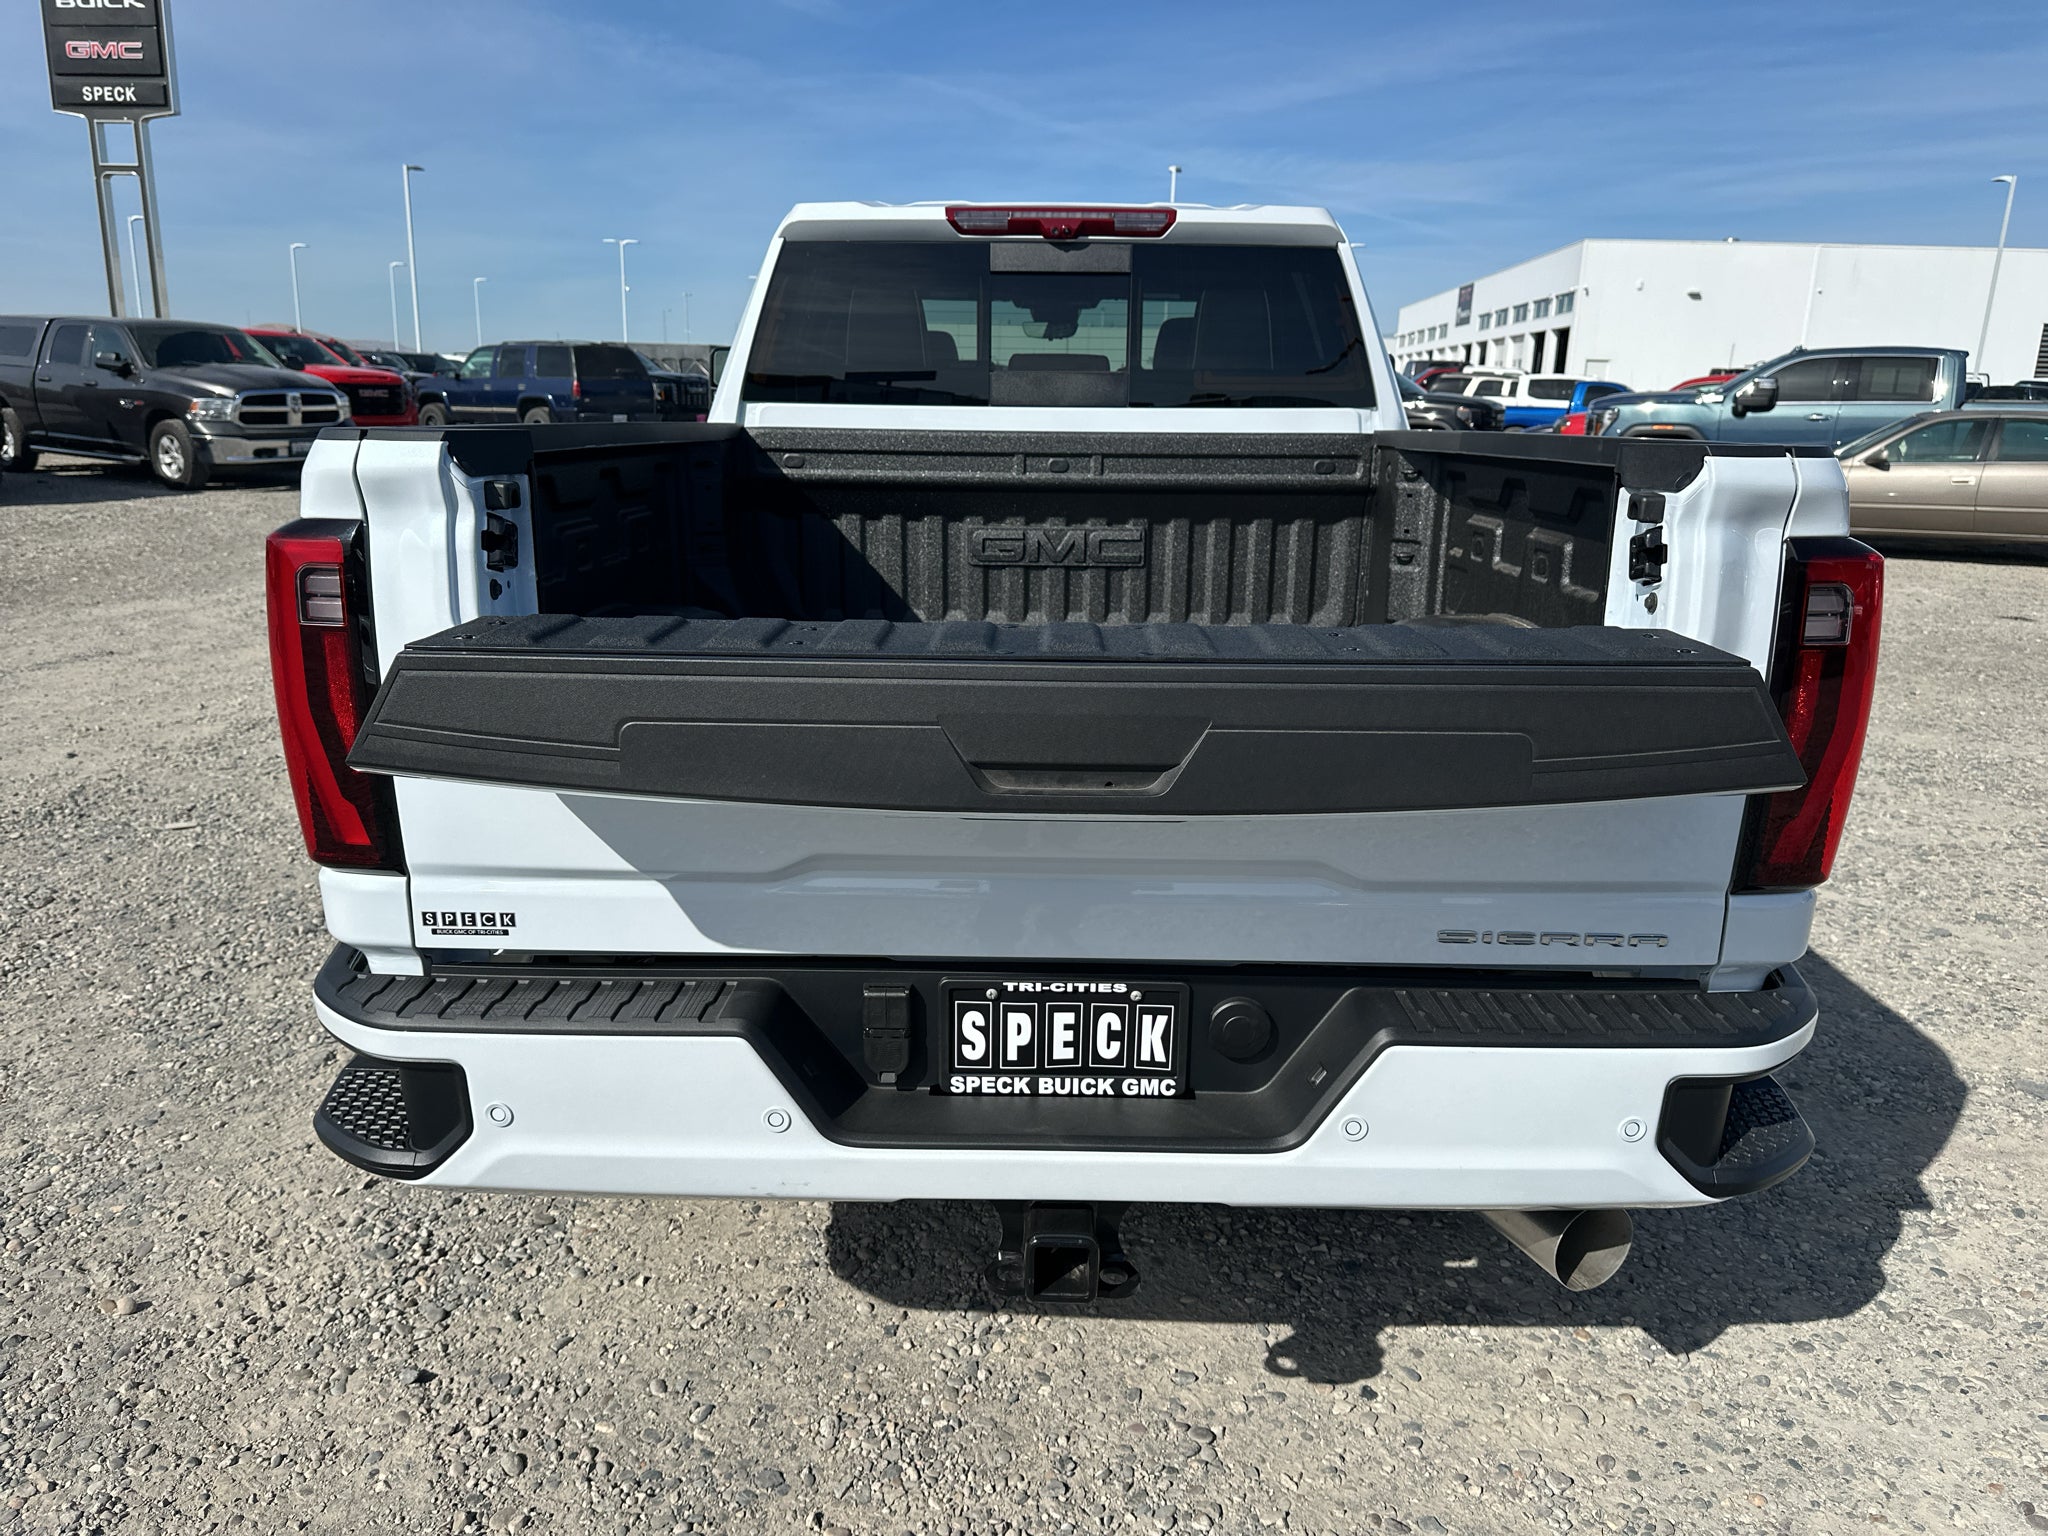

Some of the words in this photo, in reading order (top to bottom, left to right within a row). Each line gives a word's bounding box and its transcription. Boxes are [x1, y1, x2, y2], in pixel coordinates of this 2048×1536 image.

[65, 40, 144, 59] GMC
[82, 86, 137, 102] SPECK
[971, 528, 1144, 564] GMC
[424, 912, 514, 927] SPECK
[1437, 929, 1669, 948] SIERRA
[1002, 981, 1128, 993] TRI-CITIES
[961, 1010, 1169, 1063] SPECK
[950, 1076, 1031, 1095] SPECK
[1038, 1077, 1115, 1096] BUICK
[1121, 1078, 1176, 1097] GMC
